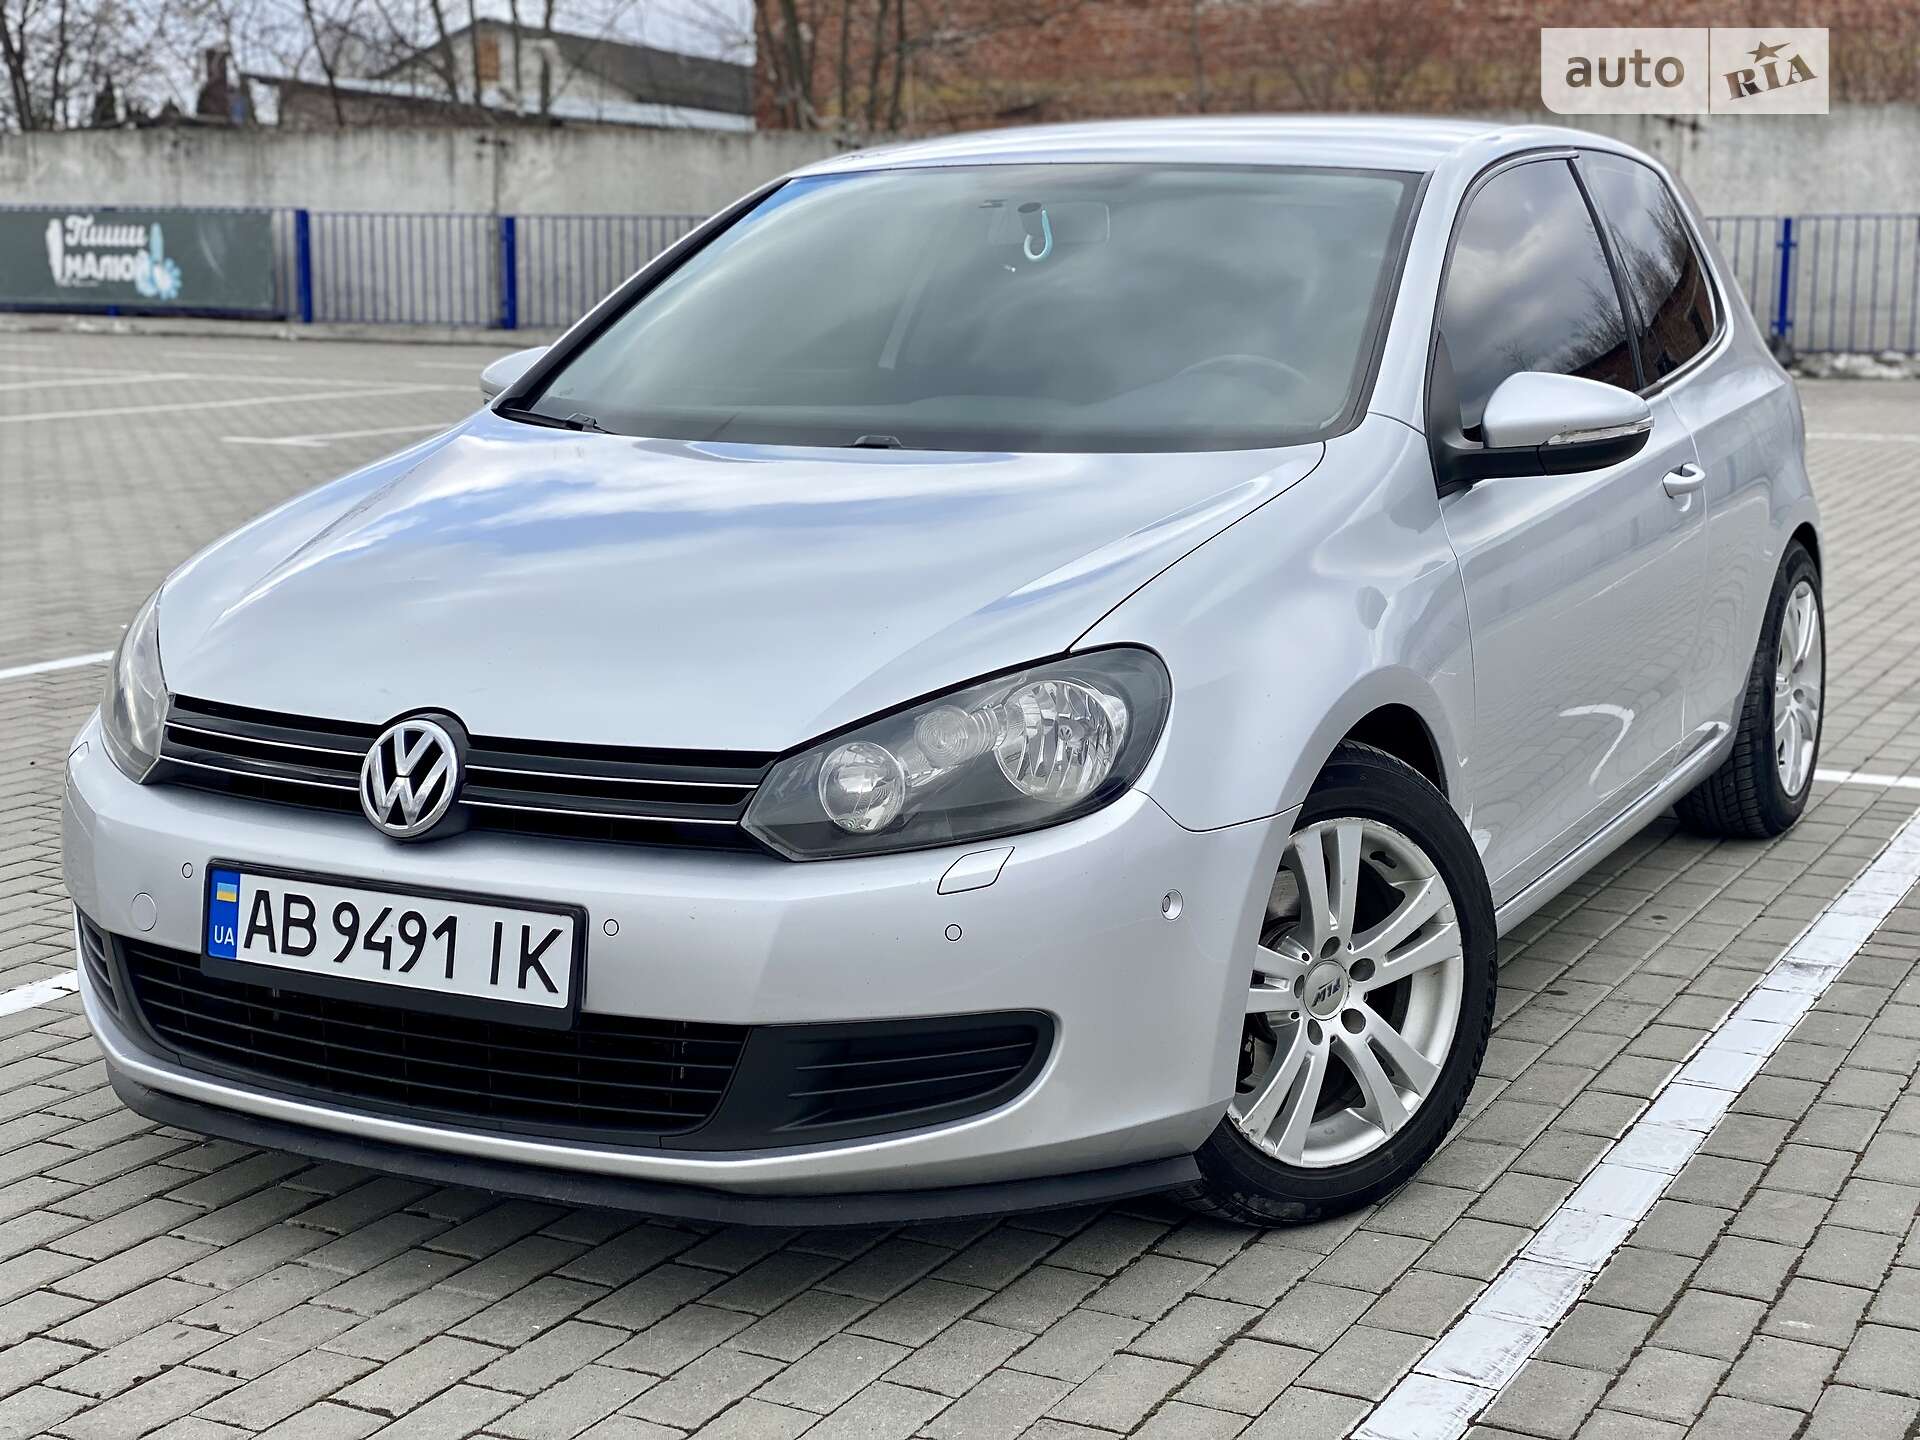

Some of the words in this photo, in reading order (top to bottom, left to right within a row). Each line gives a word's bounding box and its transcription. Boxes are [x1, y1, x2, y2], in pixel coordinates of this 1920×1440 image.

[214, 924, 235, 946] UA
[243, 889, 317, 957] AB
[332, 901, 458, 979] 9491
[489, 922, 564, 994] IK
